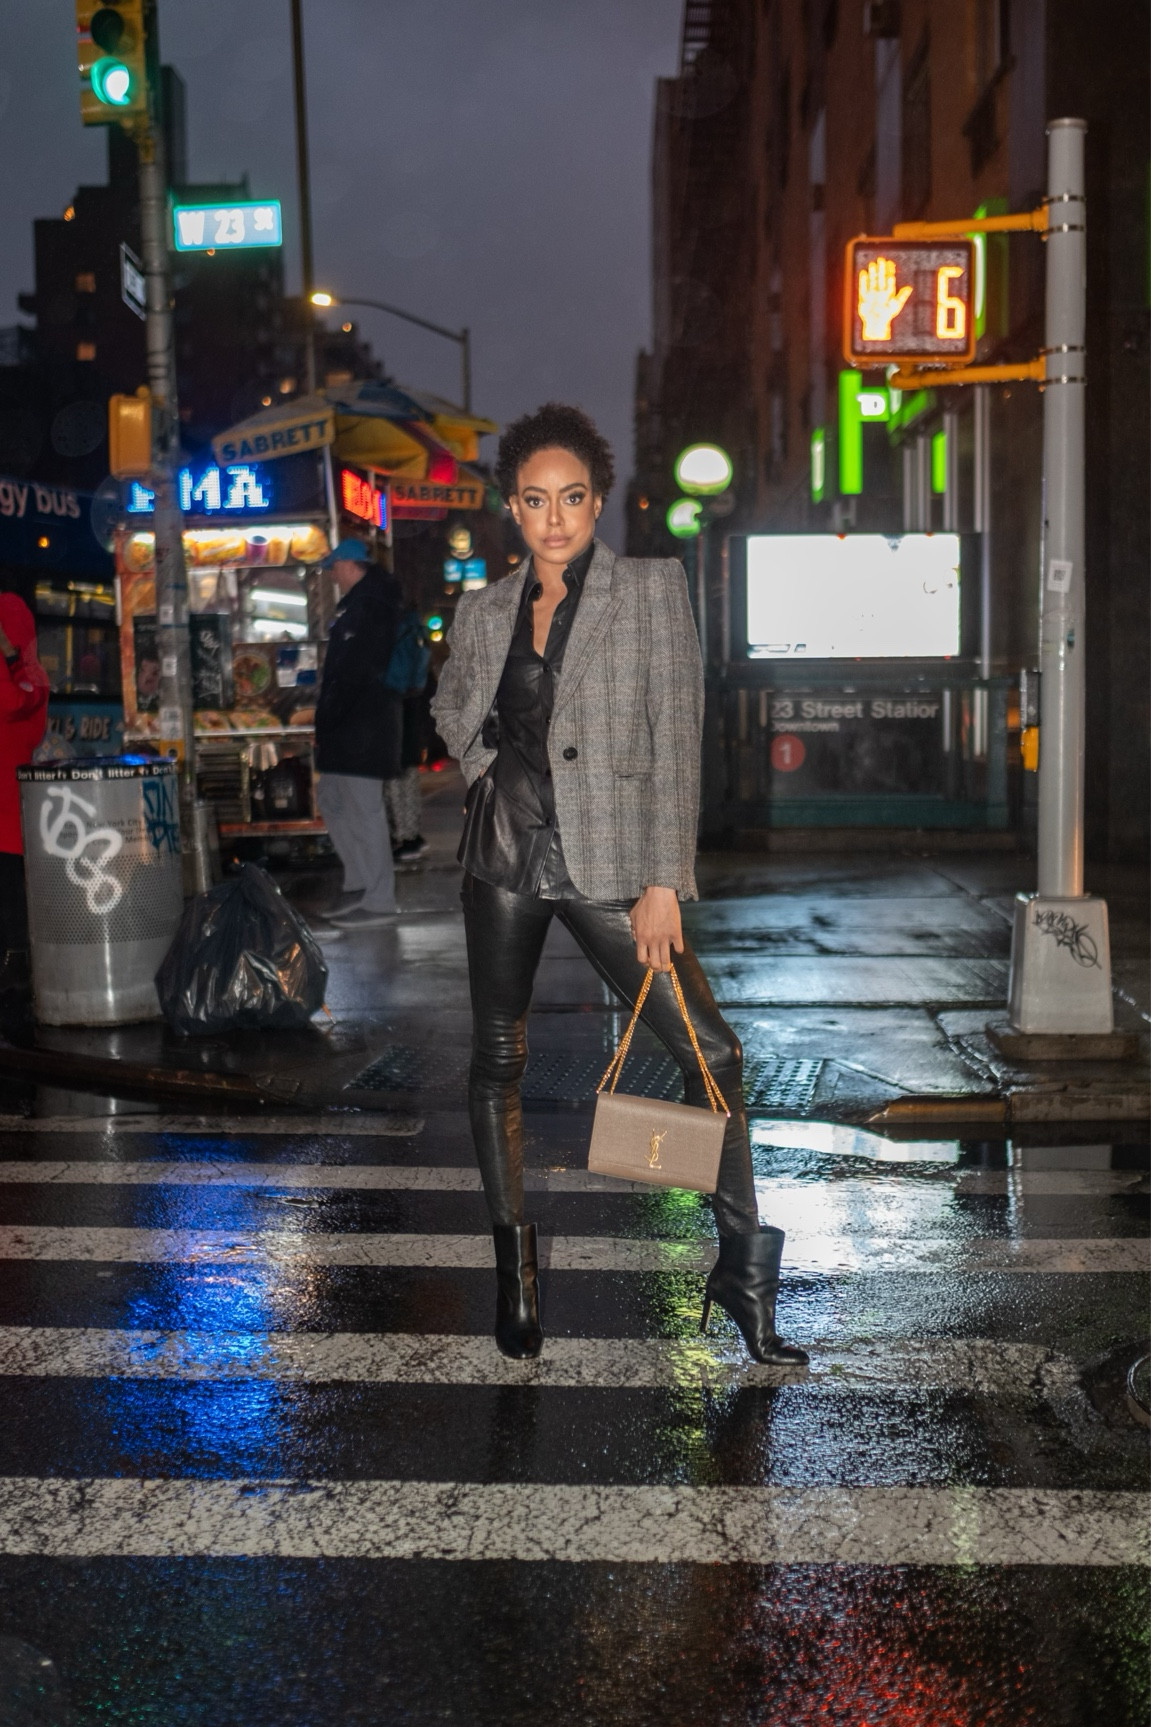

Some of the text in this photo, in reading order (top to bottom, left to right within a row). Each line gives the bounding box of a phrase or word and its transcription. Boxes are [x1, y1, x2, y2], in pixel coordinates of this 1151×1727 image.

[178, 211, 205, 246] W
[214, 209, 246, 244] 23
[936, 266, 966, 339] 6
[221, 419, 328, 462] SABRETT
[32, 482, 81, 519] bus
[394, 484, 477, 503] SABRETT
[771, 701, 794, 719] 23
[801, 701, 864, 719] Street
[80, 715, 111, 740] RIDE
[780, 742, 792, 765] 1
[34, 769, 56, 780] litter
[108, 766, 135, 778] litter
